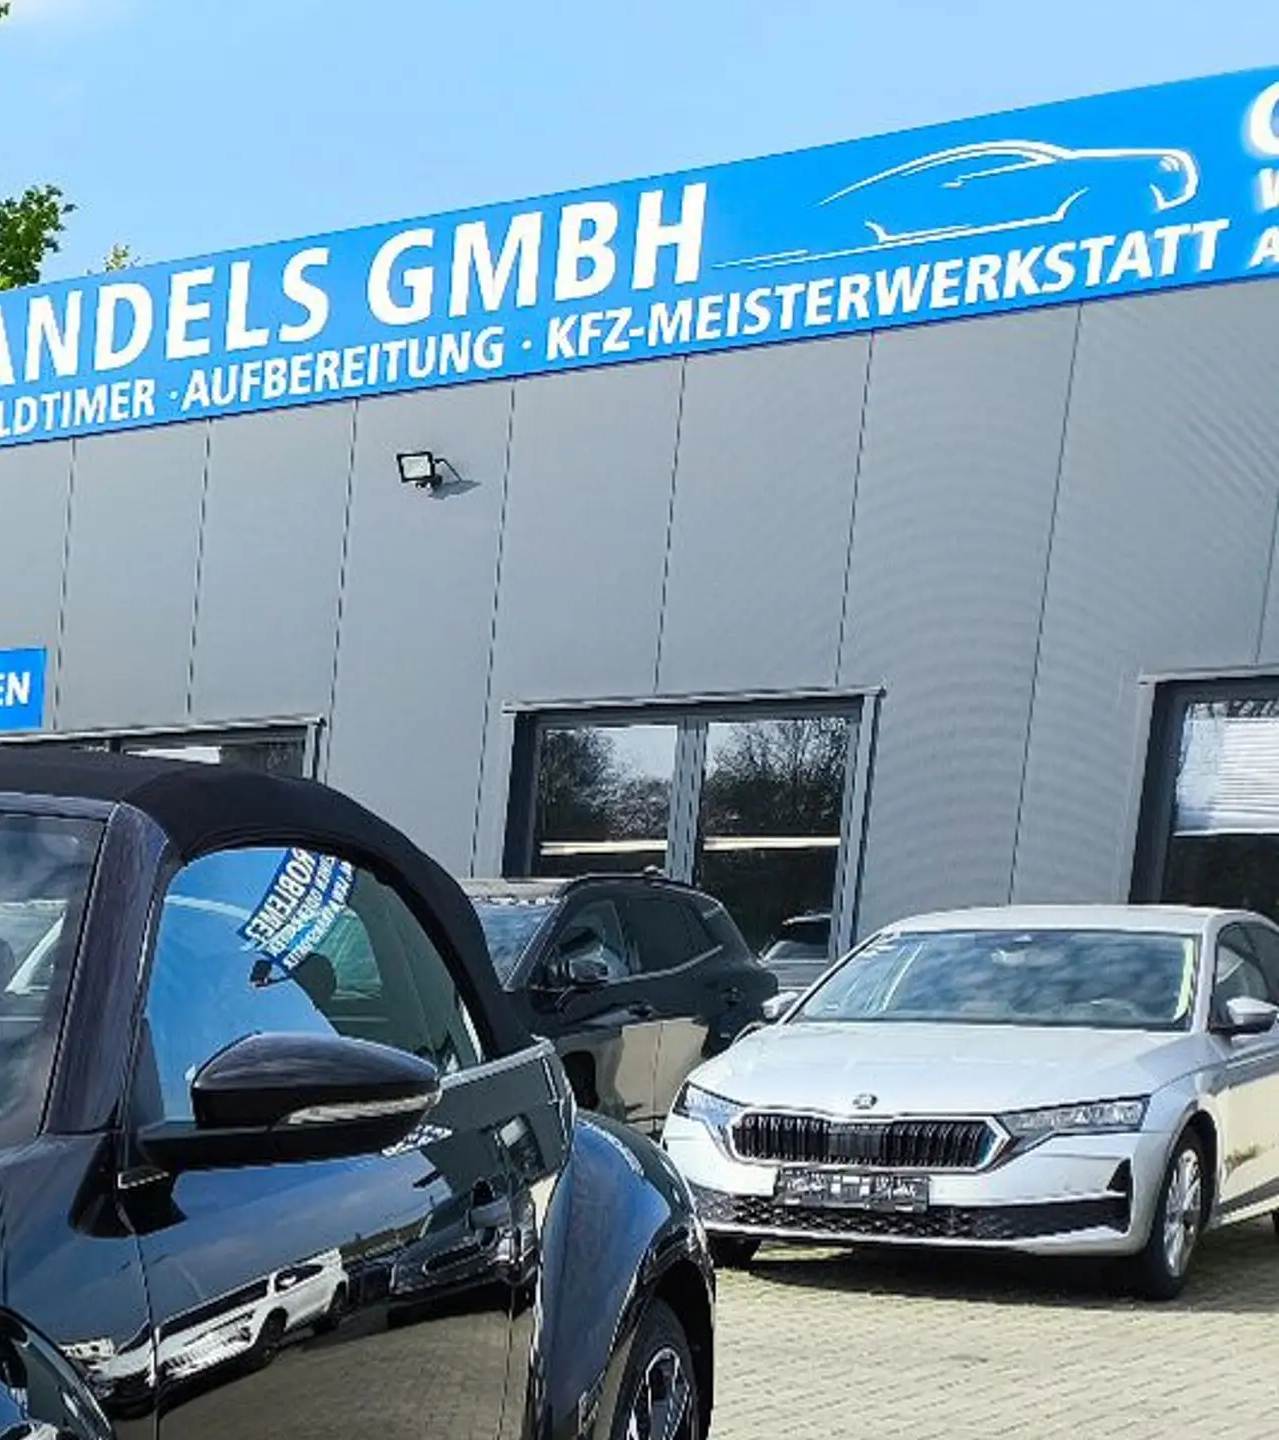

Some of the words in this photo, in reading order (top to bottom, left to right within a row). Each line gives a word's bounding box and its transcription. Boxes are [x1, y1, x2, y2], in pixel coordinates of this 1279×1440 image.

[179, 327, 504, 412] AUFBEREITUNG
[546, 220, 1229, 361] KFZ-MEISTERWERKSTATT
[366, 182, 708, 325] GMBH
